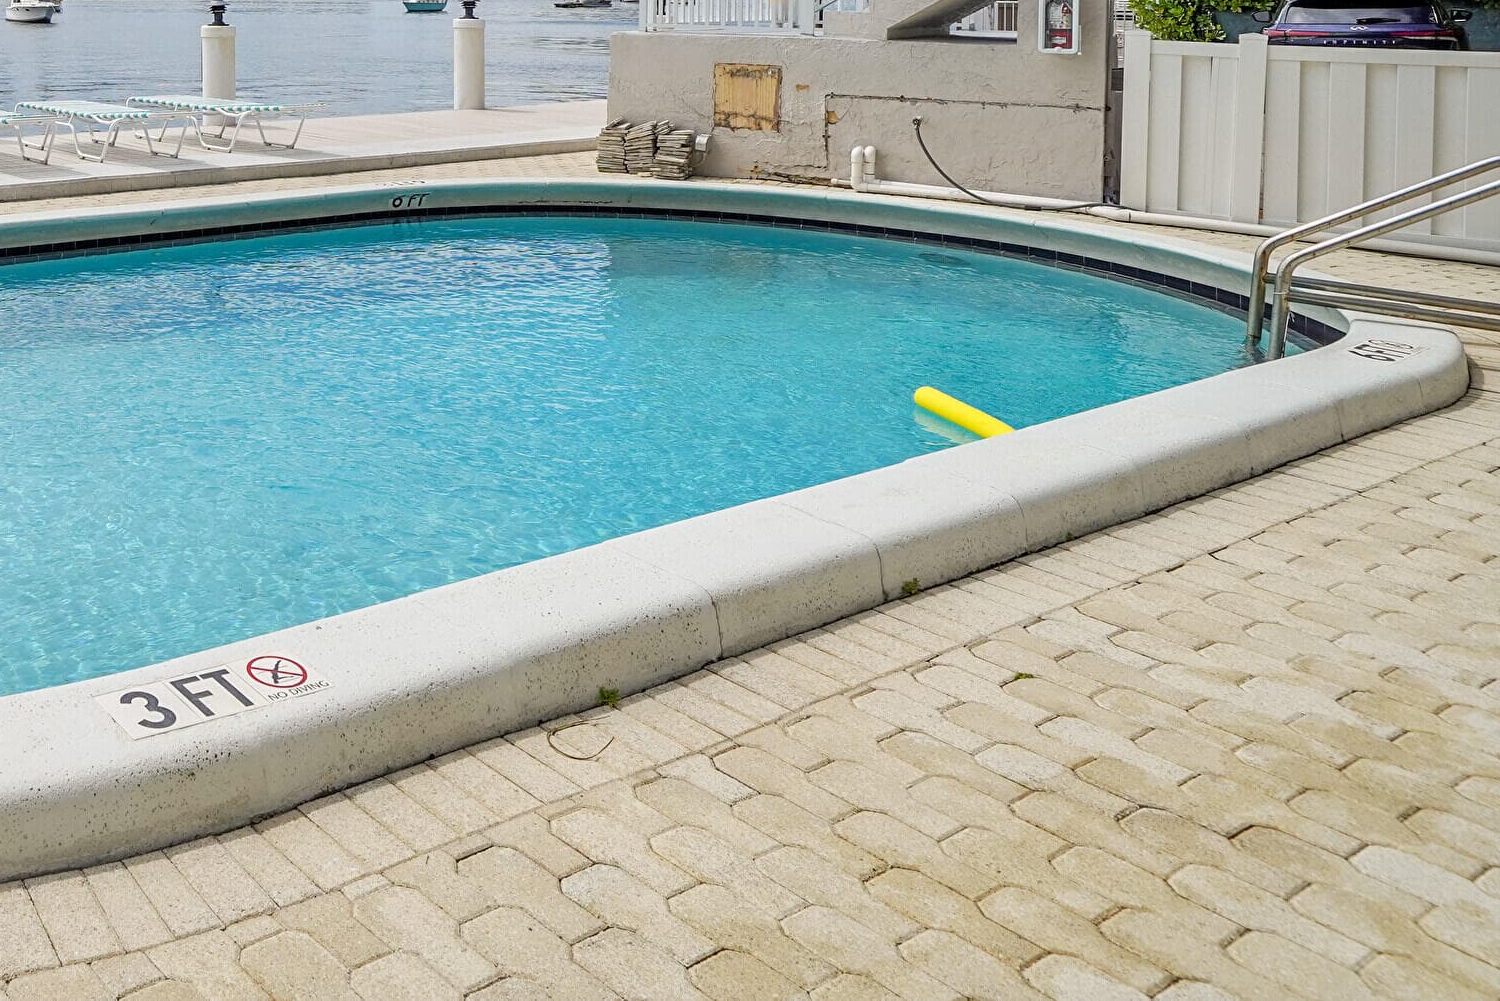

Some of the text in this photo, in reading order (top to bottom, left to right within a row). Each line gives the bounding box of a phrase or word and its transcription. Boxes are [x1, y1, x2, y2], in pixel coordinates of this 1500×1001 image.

[392, 193, 430, 208] 6 FT
[119, 668, 255, 729] 3 FT
[267, 680, 330, 701] NO DIVING
